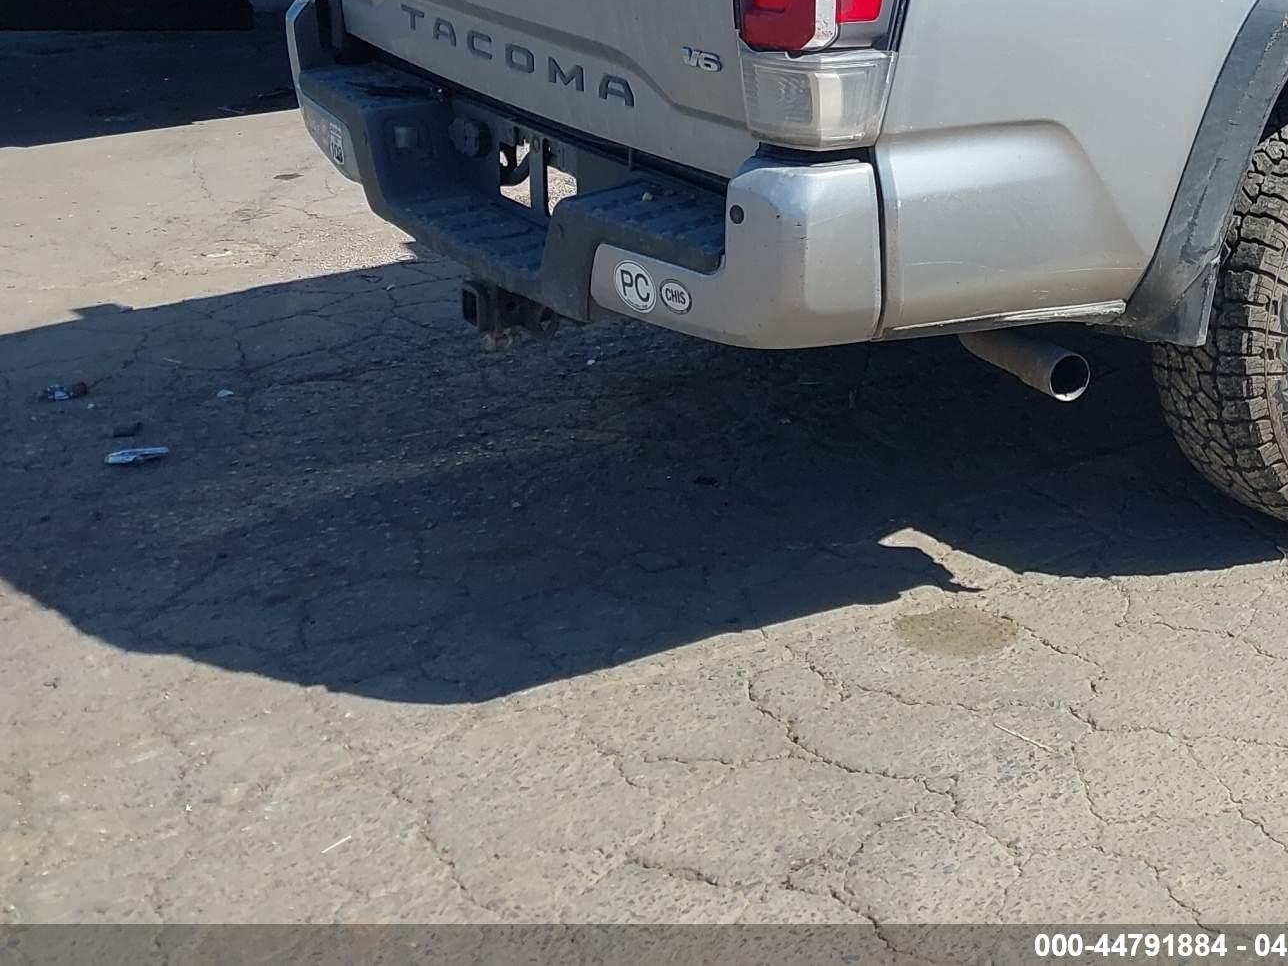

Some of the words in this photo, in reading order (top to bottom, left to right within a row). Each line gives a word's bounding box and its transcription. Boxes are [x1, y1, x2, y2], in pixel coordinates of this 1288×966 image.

[401, 4, 635, 107] TACOMA
[681, 46, 723, 73] V6
[620, 269, 651, 303] PC
[665, 287, 687, 305] CHIS
